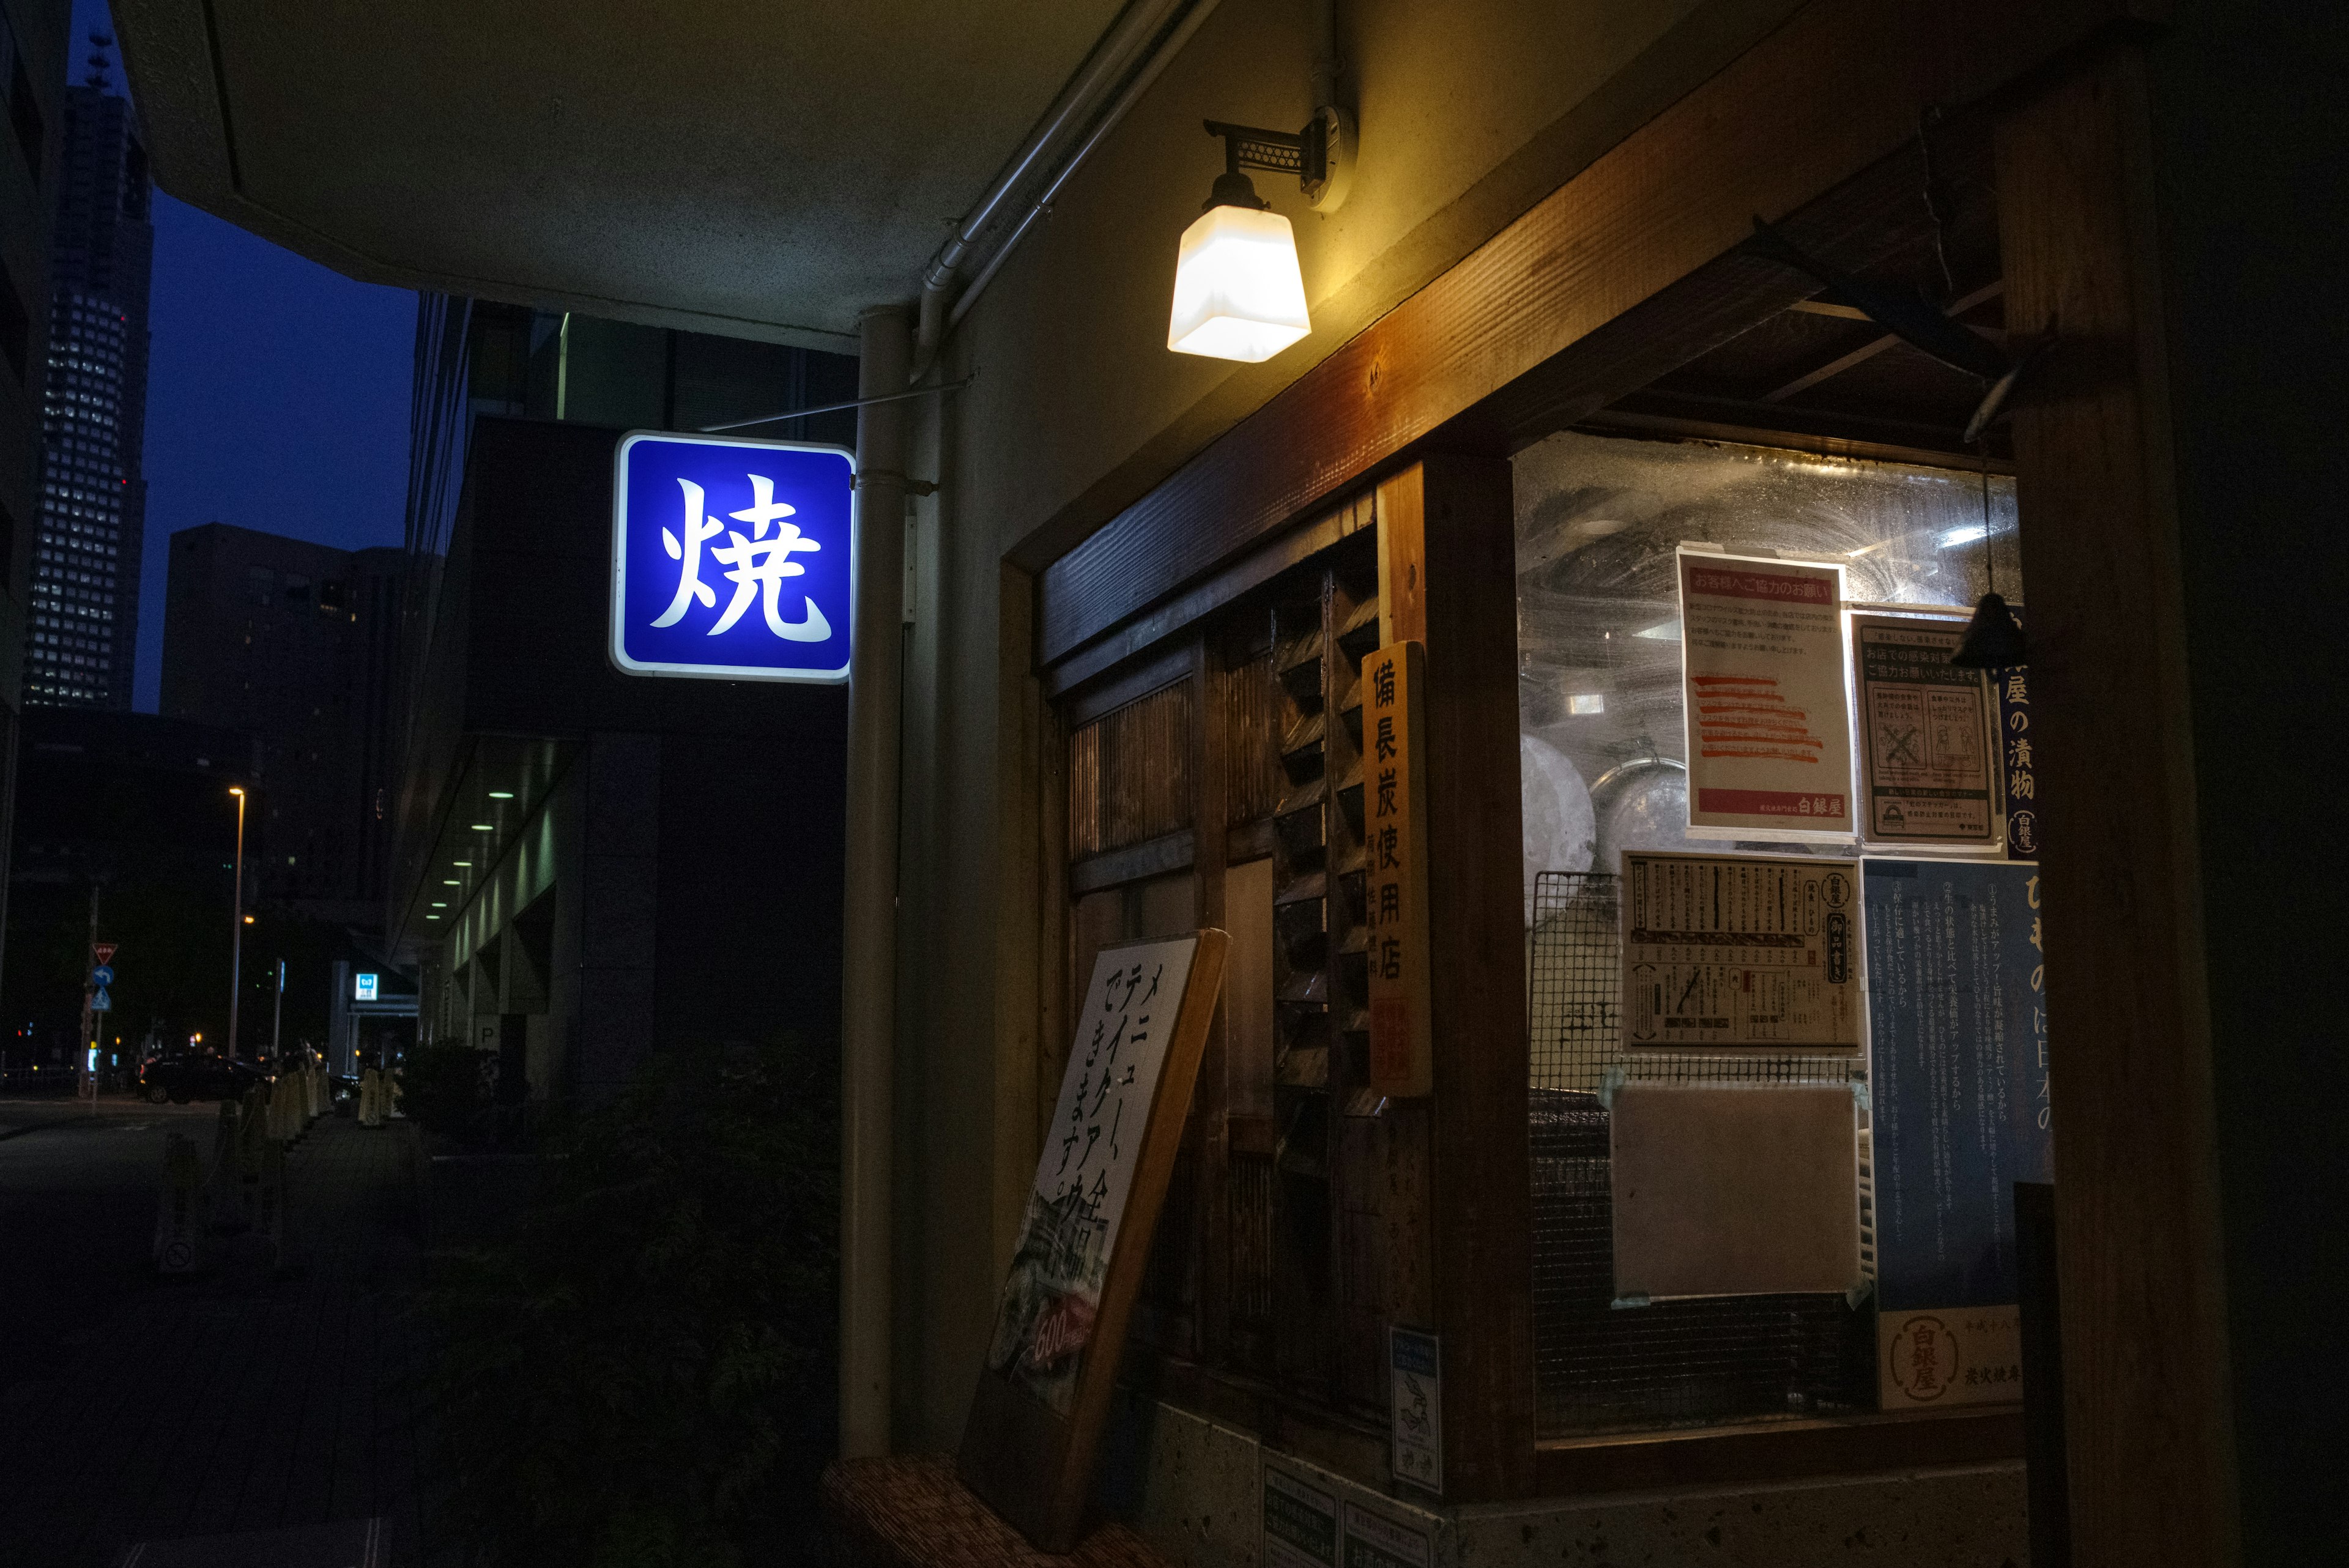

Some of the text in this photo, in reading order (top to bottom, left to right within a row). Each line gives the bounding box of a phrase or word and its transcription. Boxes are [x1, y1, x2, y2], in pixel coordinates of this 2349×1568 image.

[649, 473, 832, 642] 焼
[1694, 574, 1828, 598] お客様へご協力のお願い
[1868, 664, 1978, 683] ご協力お願いいたします。
[1374, 659, 1400, 979] 備長炭使用店
[1798, 796, 1842, 815] 白銀屋
[2018, 814, 2032, 848] 白銀屋
[1829, 877, 1841, 904] 白銀屋
[1831, 920, 1844, 980] 御品書き
[1891, 880, 1907, 1008] ③保存に適しているから
[1056, 968, 1123, 1196] できます。
[1912, 1325, 1939, 1391] 白銀屋
